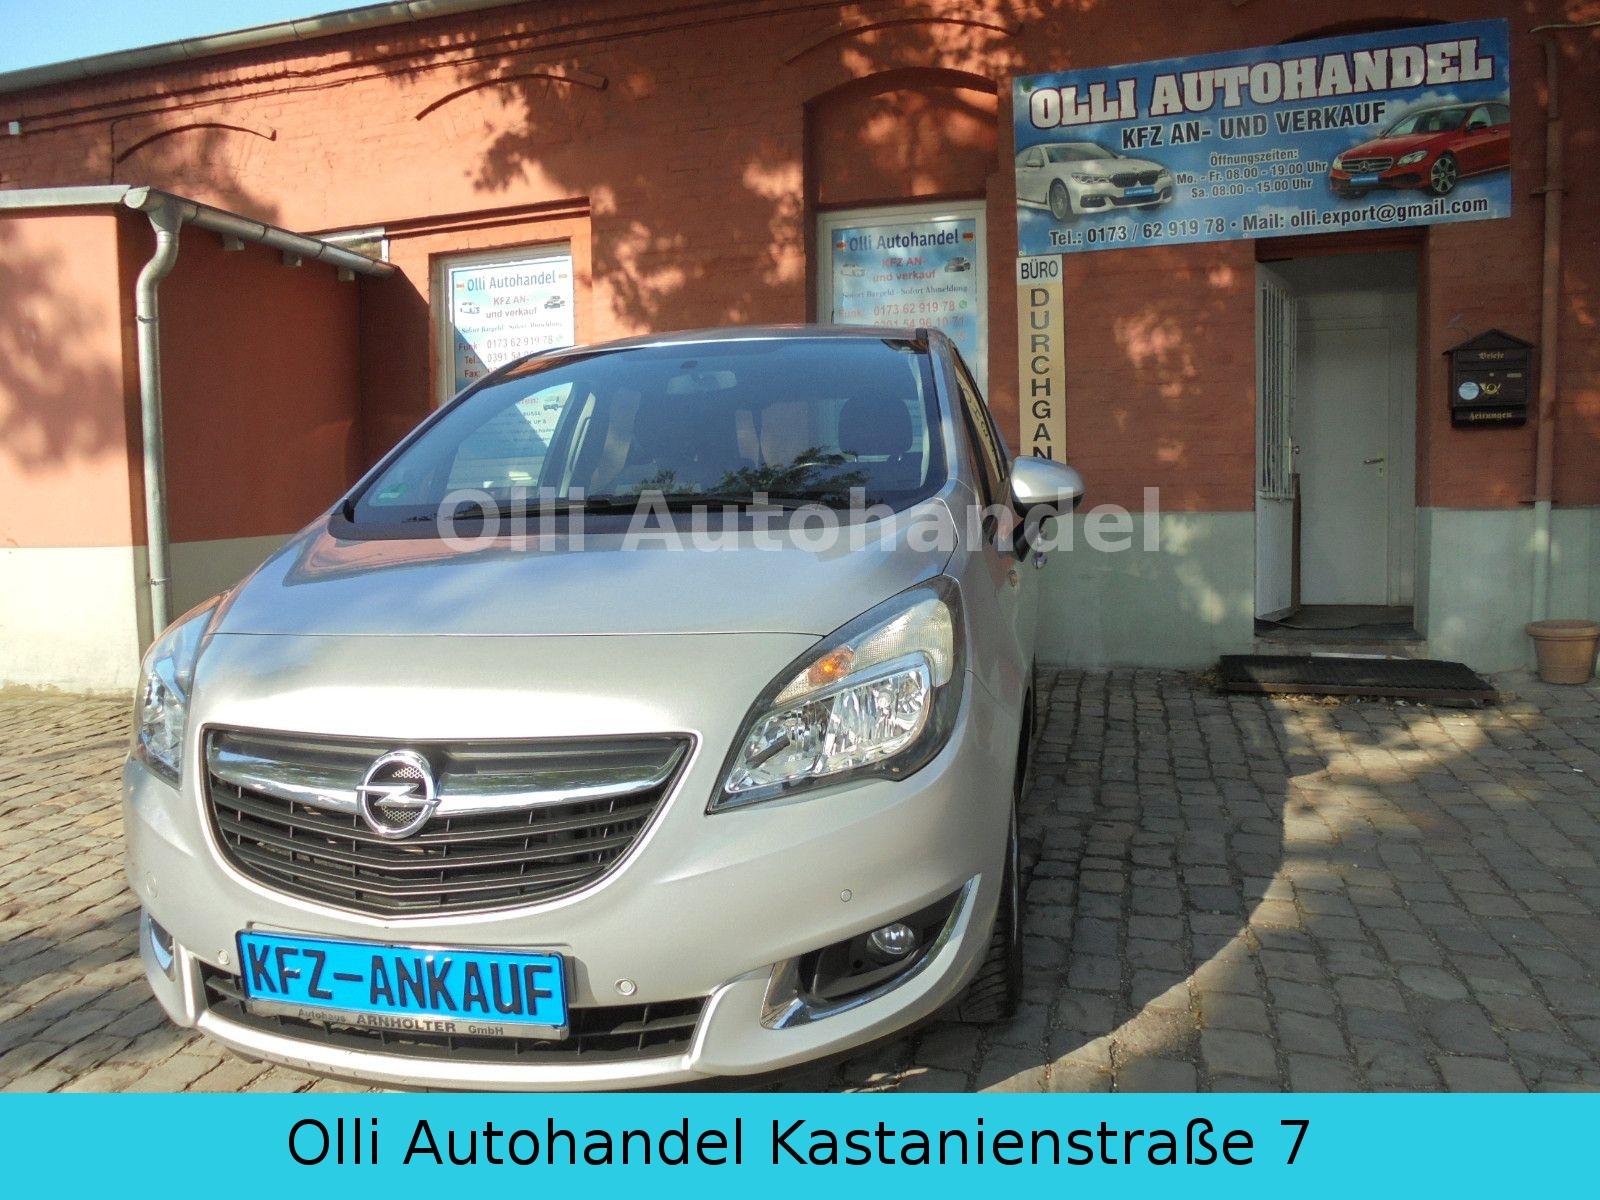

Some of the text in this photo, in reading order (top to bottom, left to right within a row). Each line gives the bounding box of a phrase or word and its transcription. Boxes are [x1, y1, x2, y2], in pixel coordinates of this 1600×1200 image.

[1030, 36, 1495, 129] OLLI AUTOHANDEL
[1121, 101, 1386, 149] KFZ AN- UND VERKAUF
[1210, 149, 1299, 167] Öffnungszeiten:
[1176, 173, 1197, 185] Mo.
[1209, 171, 1223, 182] Fr.
[1226, 167, 1258, 181] 08.00
[1271, 163, 1303, 176] 19.00
[1307, 161, 1327, 174] Uhr
[1191, 187, 1209, 199] Sa.
[1212, 184, 1244, 197] 08.00
[1256, 180, 1289, 194] 15.00
[1292, 178, 1313, 190] Uhr
[1050, 230, 1082, 247] Tel.:
[1087, 226, 1127, 244] 0173
[1143, 222, 1163, 239] 62
[1168, 219, 1199, 237] 919
[1205, 217, 1225, 234] 78
[1243, 212, 1285, 232] Mail:
[1290, 197, 1488, 227] olli.export@gmail.com
[850, 229, 959, 252] Olli Autohandel
[896, 269, 937, 281] verkauf
[1021, 258, 1059, 280] BÜRO
[467, 270, 556, 292] Olli Autohandel
[485, 309, 503, 319] und
[873, 304, 899, 317] 0173
[902, 303, 917, 315] 62
[918, 301, 939, 314] 919
[942, 301, 956, 313] 78
[487, 339, 508, 349] 0173
[510, 337, 522, 347] 62
[247, 942, 553, 1016] KFZ-ANKAUF
[356, 1013, 457, 1034] ARNHOLTER
[468, 1024, 504, 1036] GmbH
